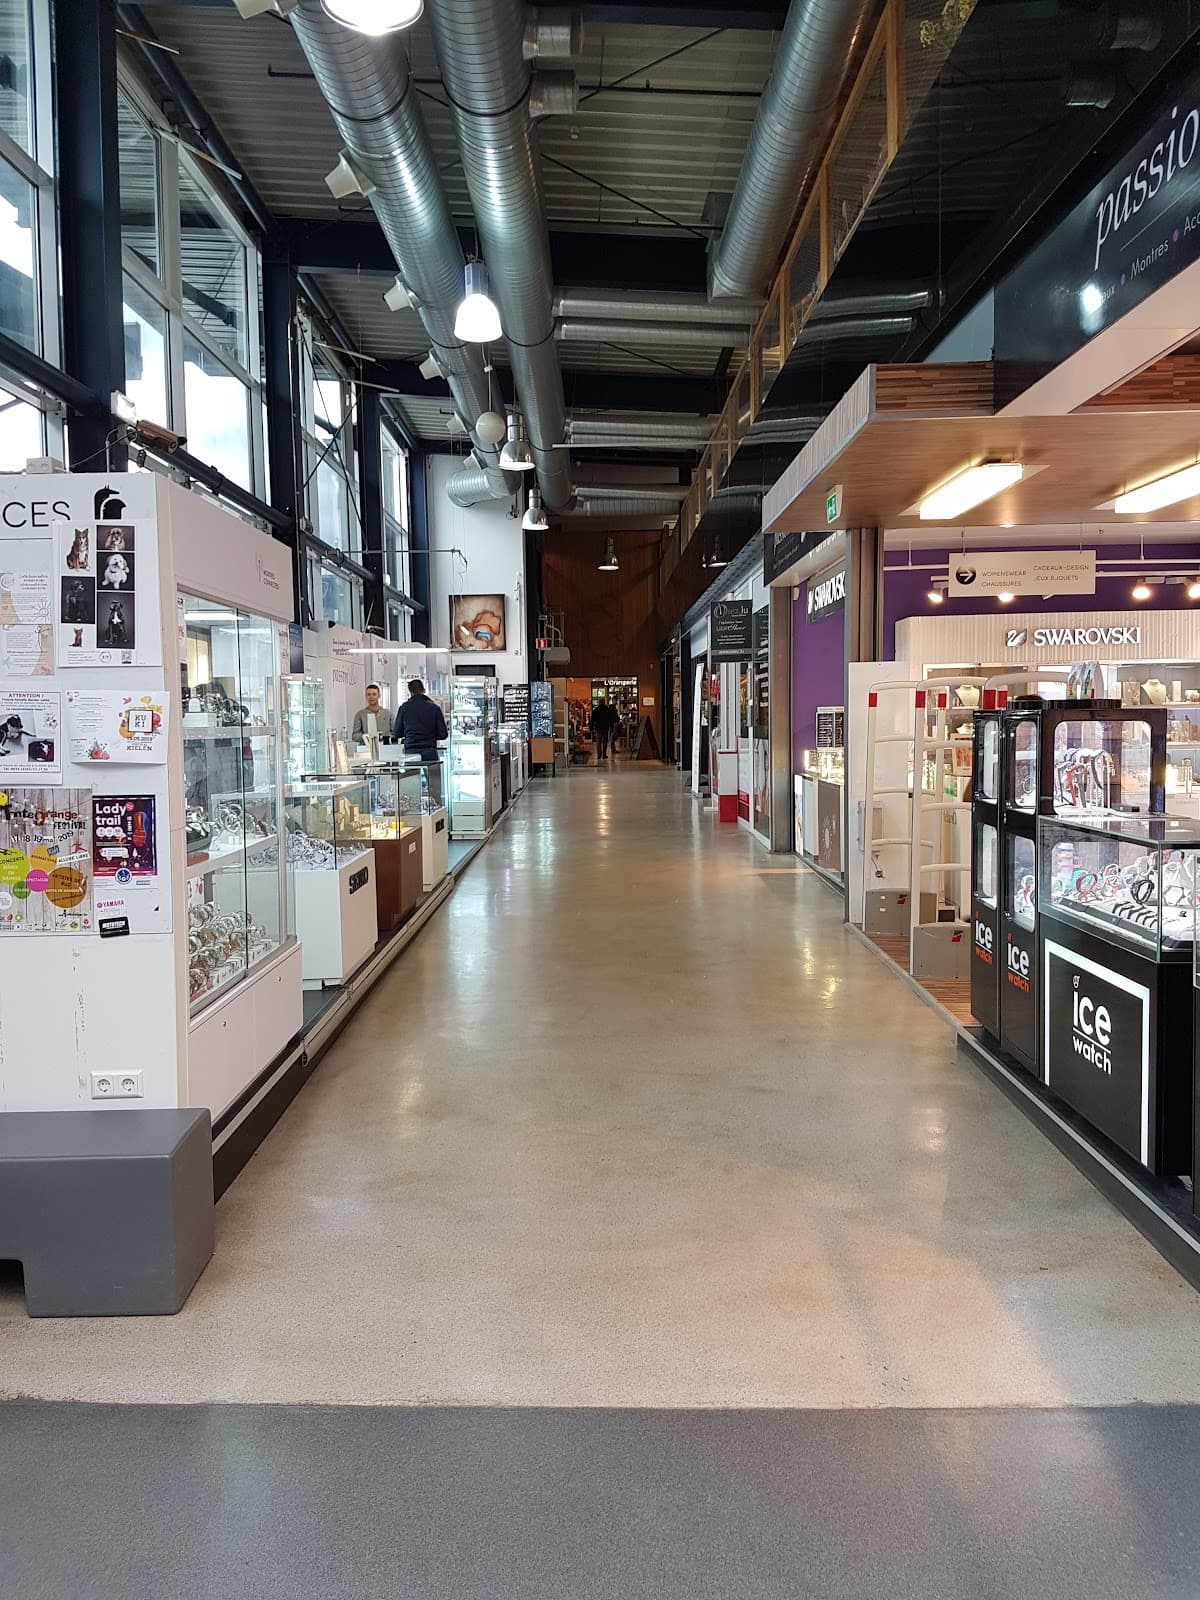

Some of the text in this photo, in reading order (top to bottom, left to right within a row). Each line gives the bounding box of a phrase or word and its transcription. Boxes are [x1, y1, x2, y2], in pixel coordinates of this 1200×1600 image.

[1095, 105, 1200, 271] passio
[1130, 239, 1169, 280] Montres
[2, 501, 70, 528] CES
[1033, 627, 1141, 646] SWAROVSKI
[95, 802, 127, 816] Lady
[95, 815, 121, 826] trail
[103, 899, 124, 907] YAMAHA
[975, 912, 993, 949] ice
[975, 947, 993, 966] watch
[1007, 933, 1030, 975] ice
[1007, 974, 1030, 993] watch
[1072, 975, 1112, 1046] ice
[1072, 1035, 1112, 1076] watch
